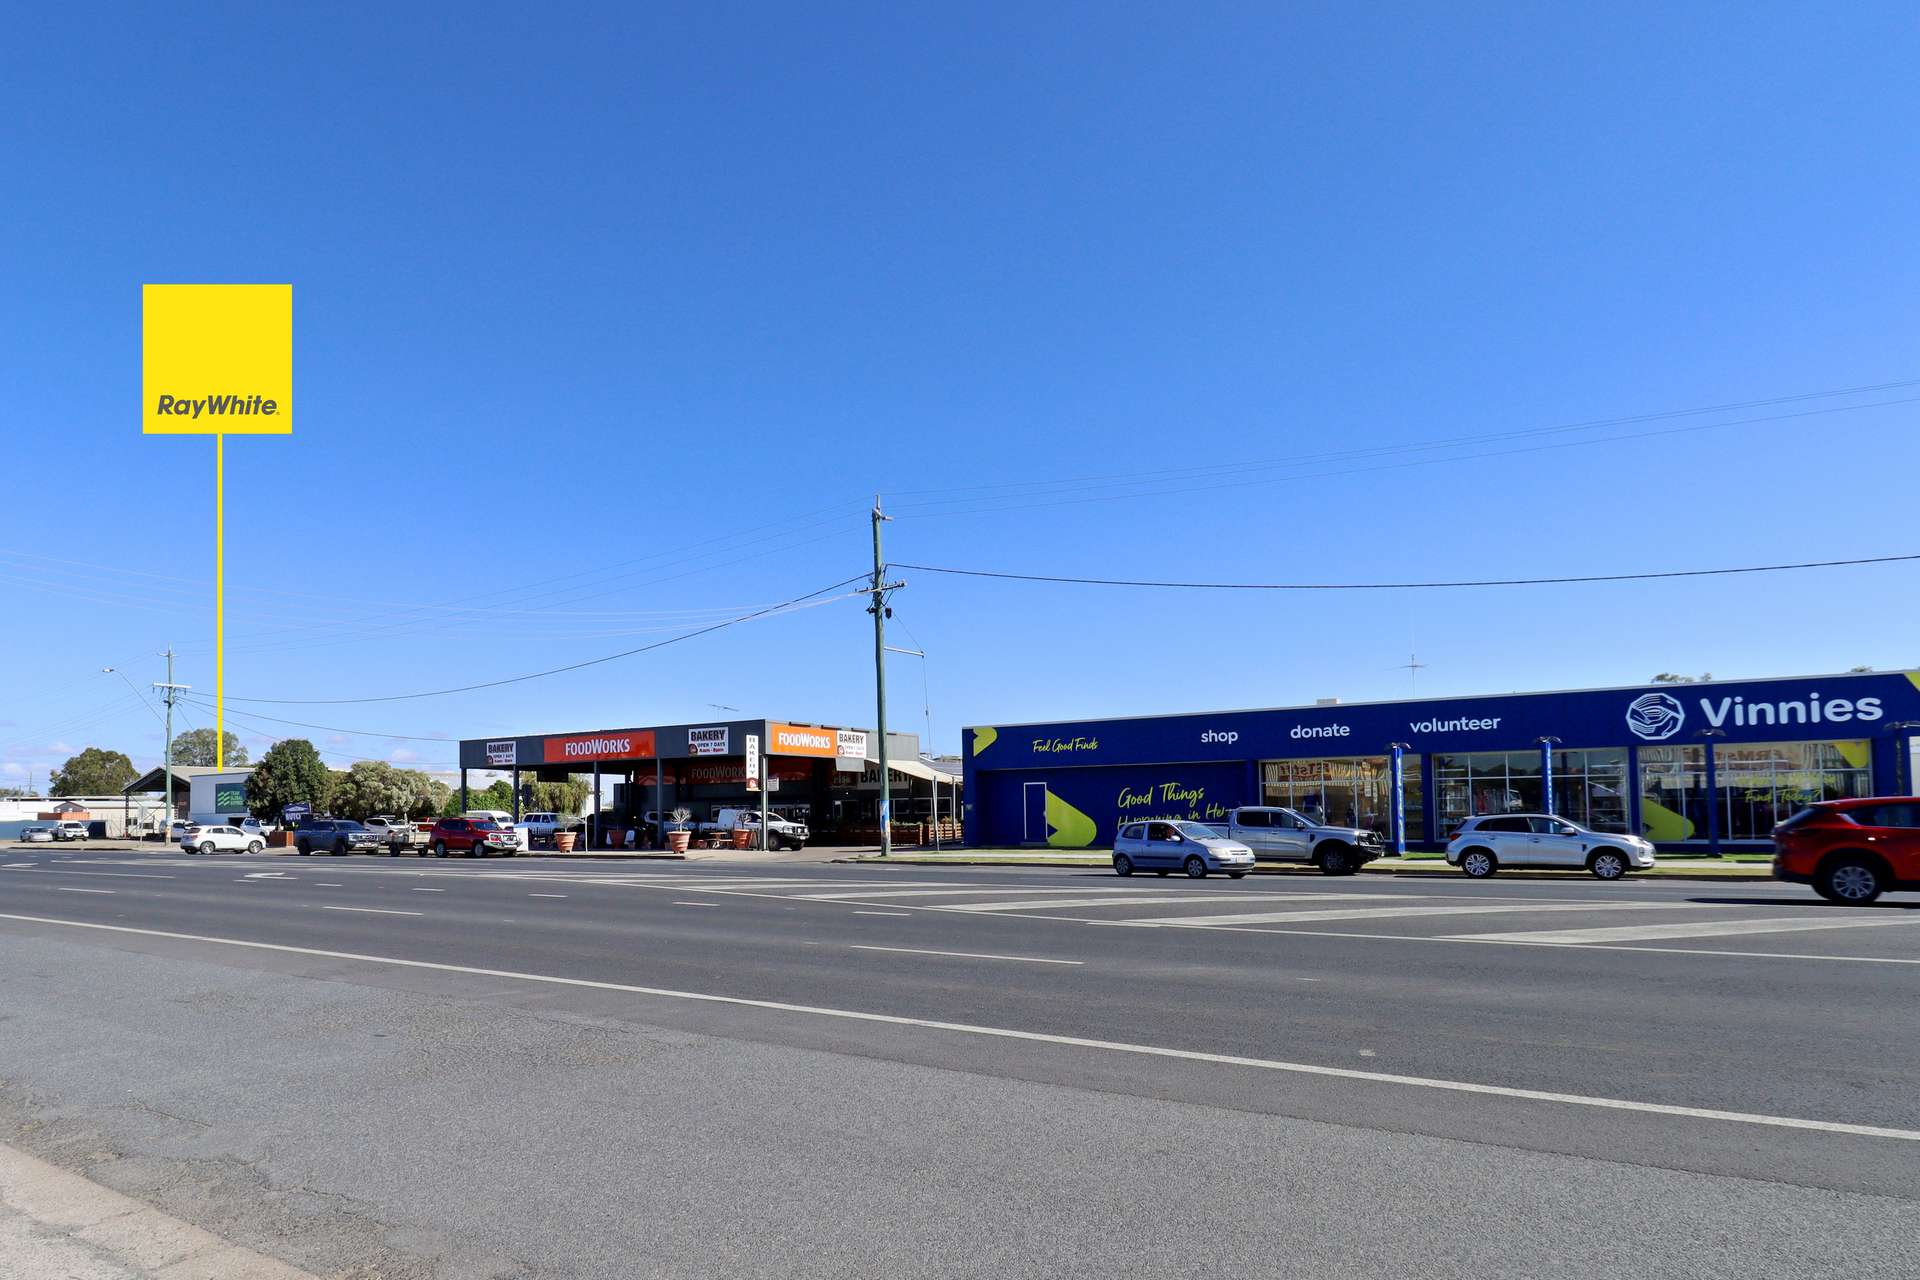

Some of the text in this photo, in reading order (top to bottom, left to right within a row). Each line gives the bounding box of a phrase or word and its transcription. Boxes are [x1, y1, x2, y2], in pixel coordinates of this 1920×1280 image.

[1700, 692, 1883, 727] Vinnies
[1290, 723, 1350, 739] donate
[1409, 716, 1501, 733] volunteer
[690, 730, 726, 741] BAKERY
[839, 733, 865, 744] BAKERY
[1201, 729, 1239, 745] shop
[488, 743, 514, 753] BAKERY
[1032, 739, 1051, 752] Feel
[1052, 738, 1074, 752] Good
[1118, 782, 1205, 808] Good Things
[1188, 809, 1201, 820] in
